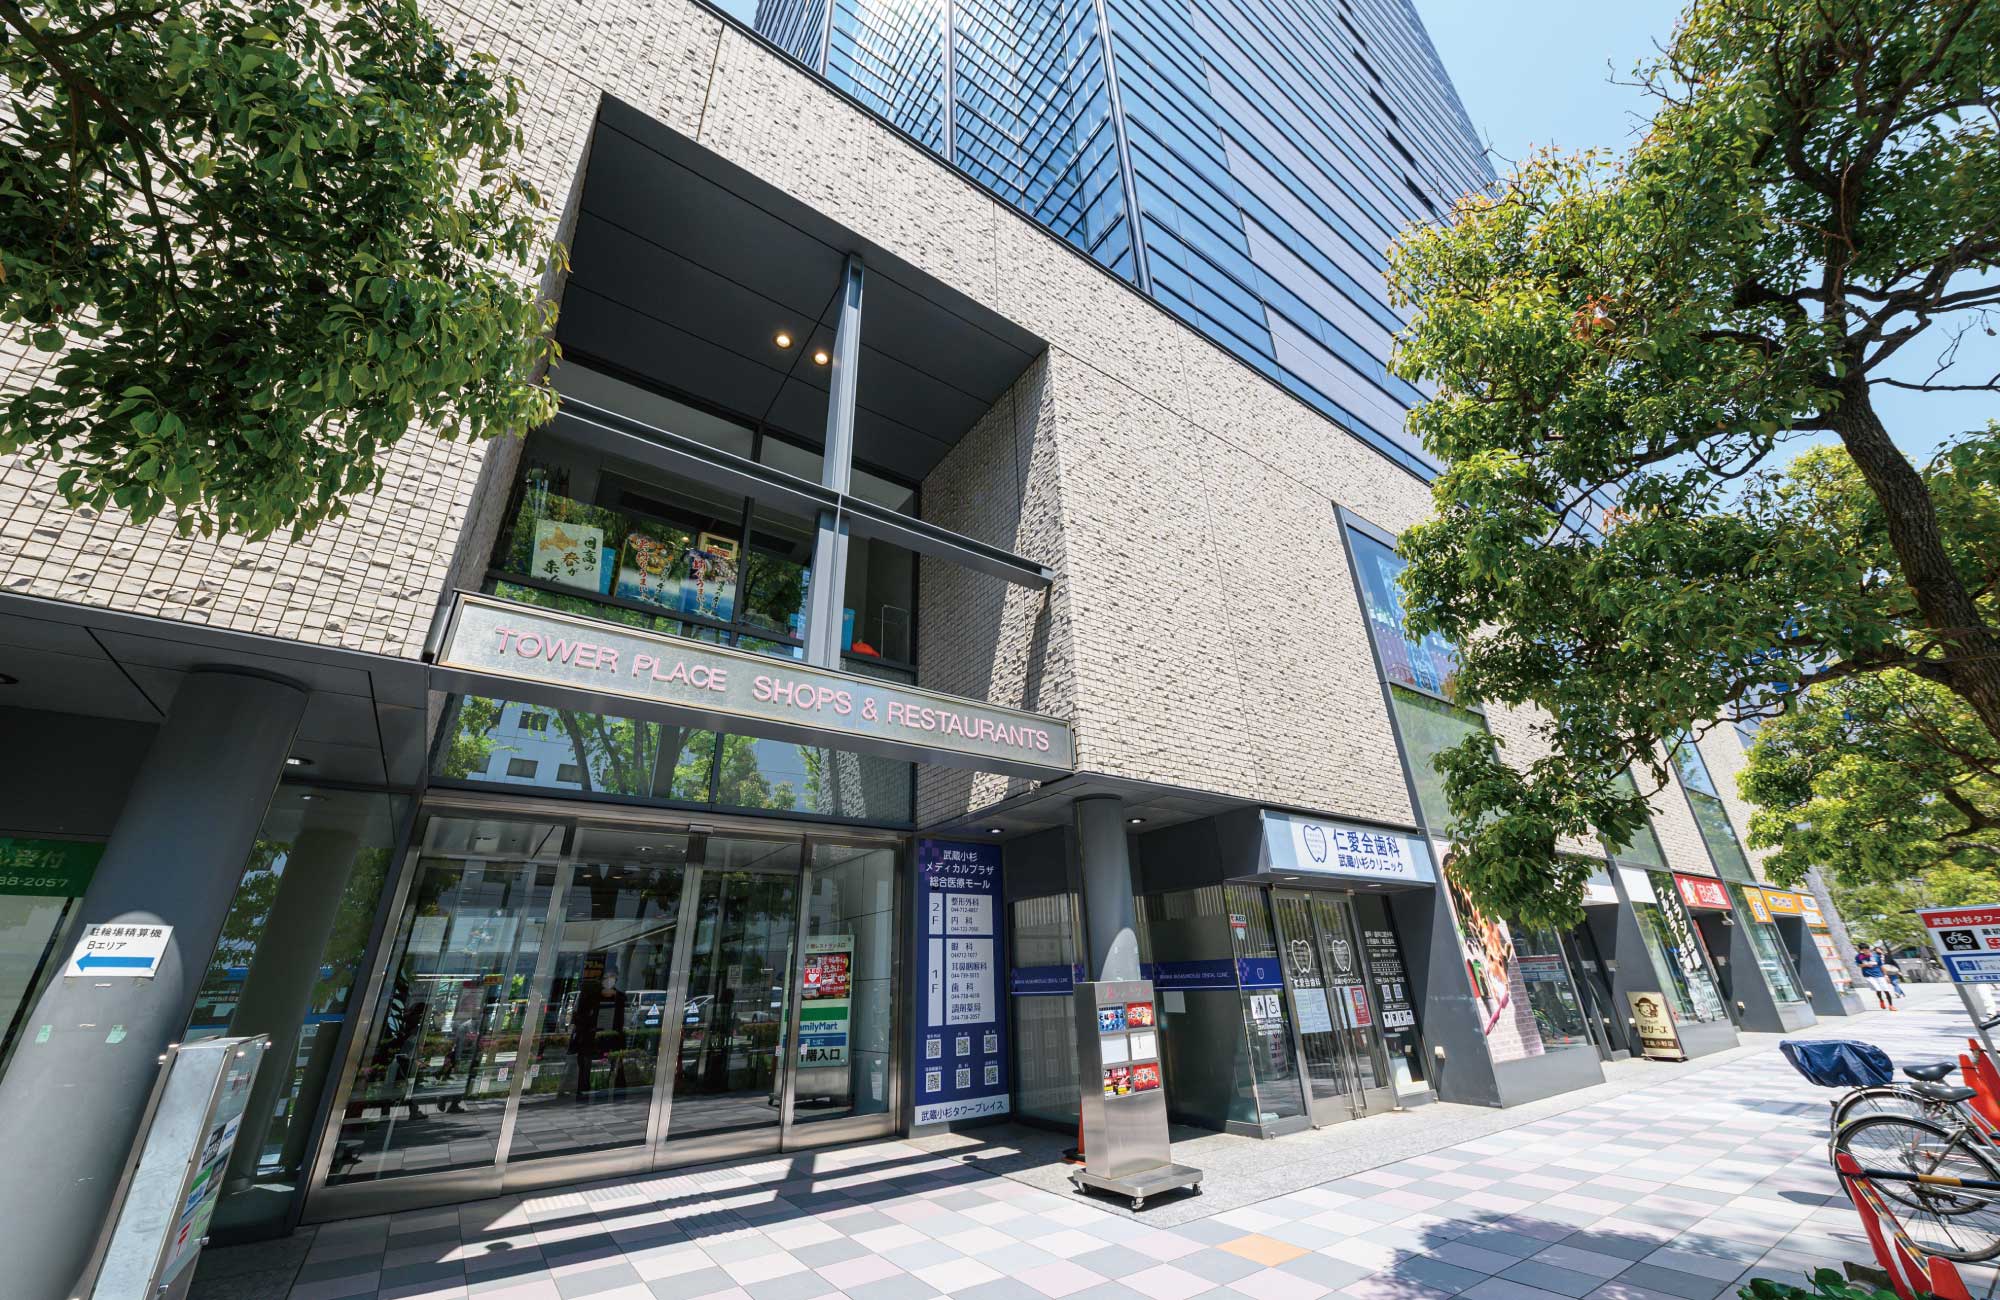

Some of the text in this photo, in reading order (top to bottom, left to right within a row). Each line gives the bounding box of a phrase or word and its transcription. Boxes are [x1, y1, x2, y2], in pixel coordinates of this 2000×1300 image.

[495, 626, 1050, 753] TOWER PLACE SHOPS & RESTAURANTS
[1333, 828, 1400, 858] 仁愛会歯科
[943, 850, 978, 862] 武蔵小杉
[1338, 853, 1404, 872] 武蔵小杉クリニック
[926, 861, 995, 876] メディカルプラザ
[929, 876, 991, 889] 総合医療モール
[87, 940, 127, 950] Bエリア
[800, 1021, 838, 1033] amilyMart
[921, 1100, 1004, 1122] 武蔵小杉タワープレイス
